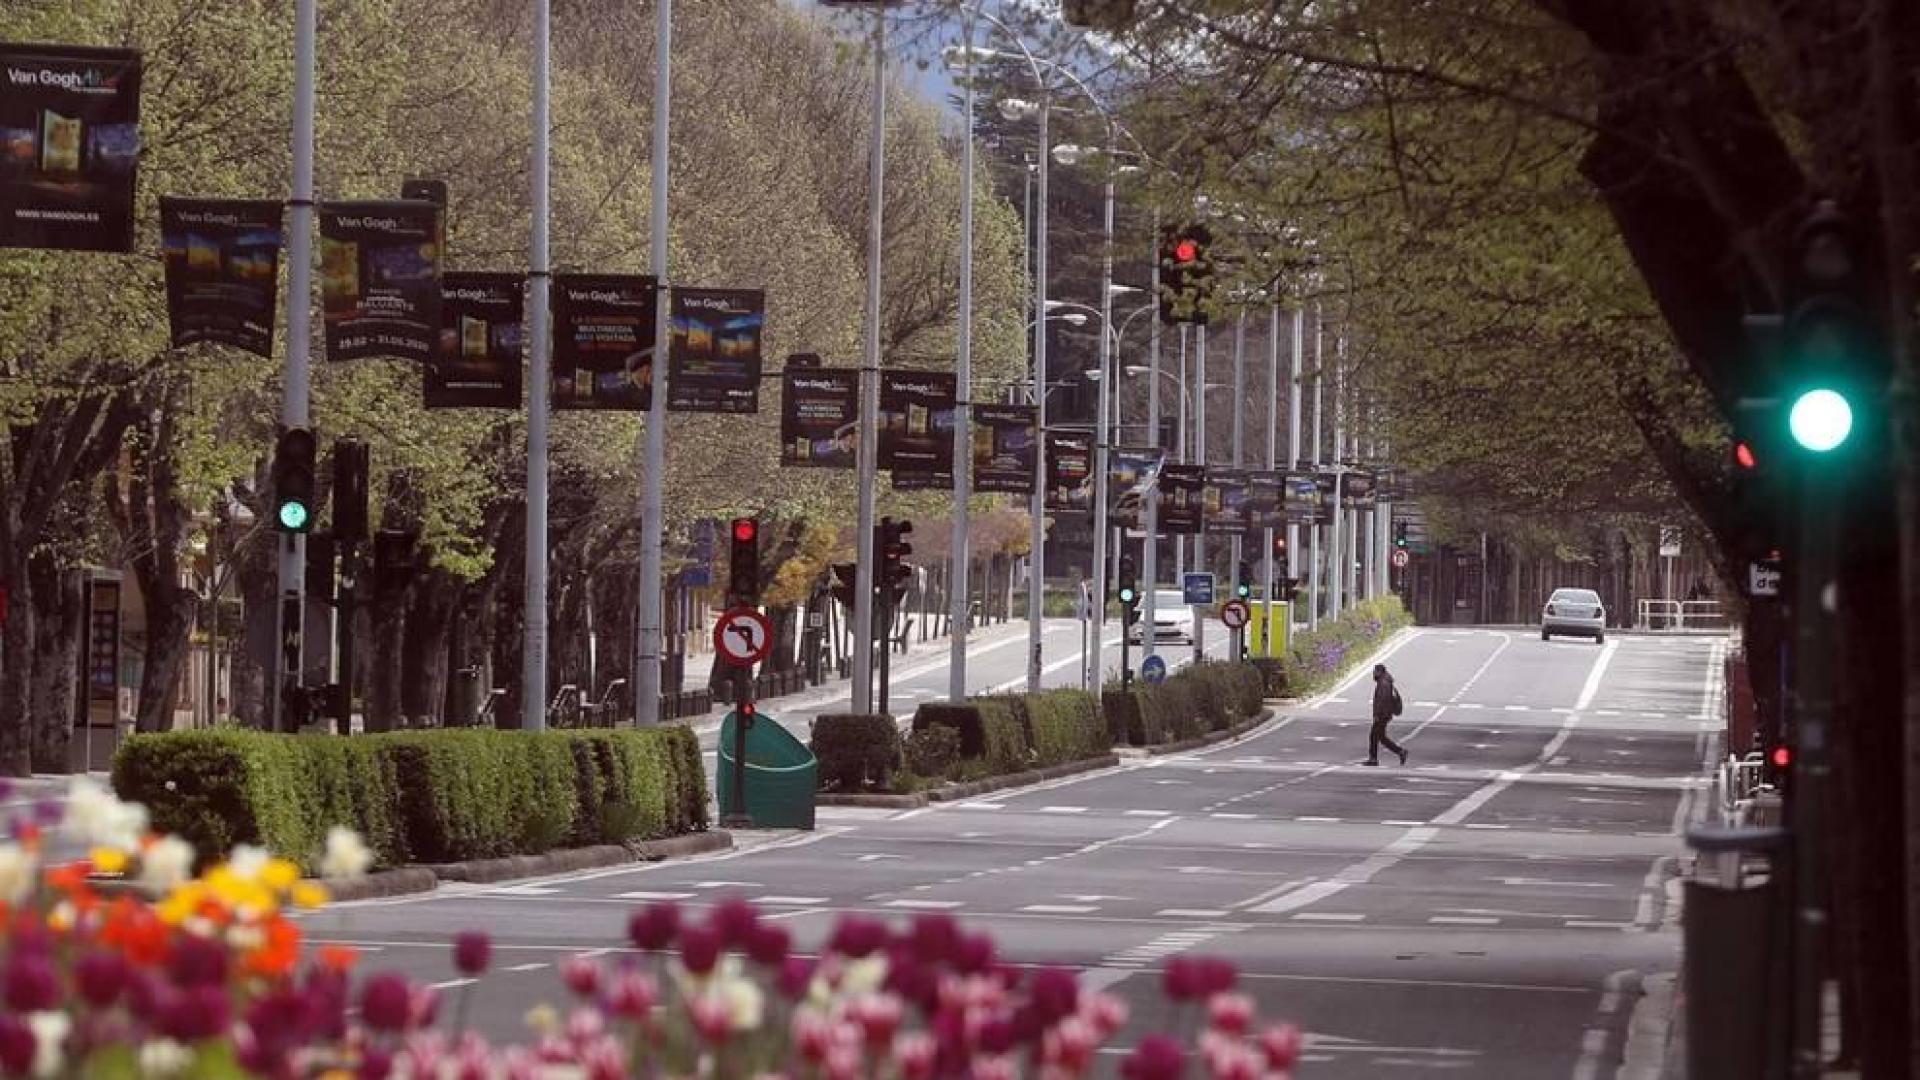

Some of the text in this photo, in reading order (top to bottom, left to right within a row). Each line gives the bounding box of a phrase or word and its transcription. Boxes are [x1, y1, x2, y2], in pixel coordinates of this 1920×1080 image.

[8, 67, 36, 83] Van
[40, 69, 80, 88] Gogh
[177, 210, 202, 222] Van
[337, 216, 361, 228] Van
[362, 217, 396, 231] Gogh
[457, 289, 486, 301] Gogh
[568, 289, 619, 304] Van Gogh
[683, 298, 701, 307] Van
